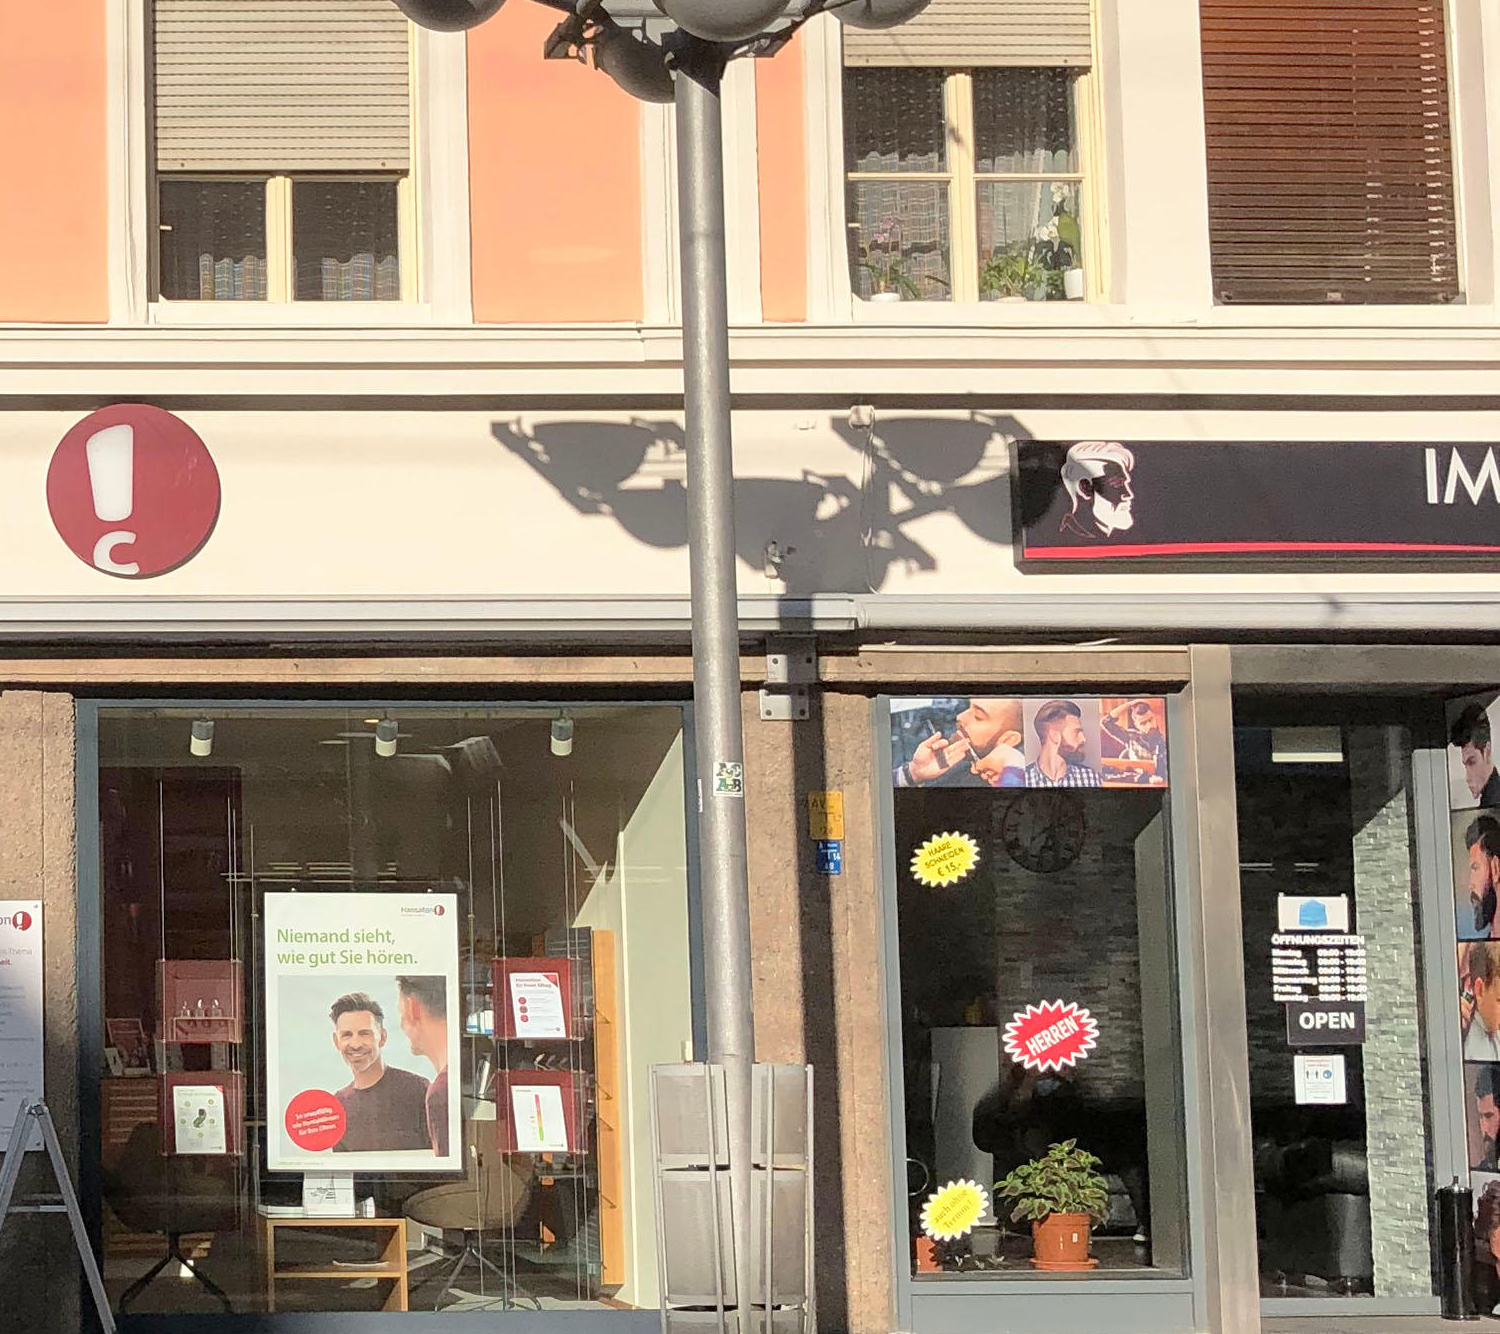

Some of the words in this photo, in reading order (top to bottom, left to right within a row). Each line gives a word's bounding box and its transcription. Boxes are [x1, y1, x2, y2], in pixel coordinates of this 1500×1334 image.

[925, 847, 965, 868] SCHNEIDEN
[928, 841, 952, 857] HAARE
[277, 929, 350, 943] Niemand
[353, 929, 396, 945] sieht,
[1271, 933, 1365, 945] ÖFFNUNGSZEITEN
[277, 950, 305, 964] wie
[309, 951, 336, 967] gut
[340, 950, 363, 964] Sie
[367, 950, 418, 964] hören.
[1299, 1012, 1355, 1029] OPEN
[1025, 1015, 1079, 1056] HERREN
